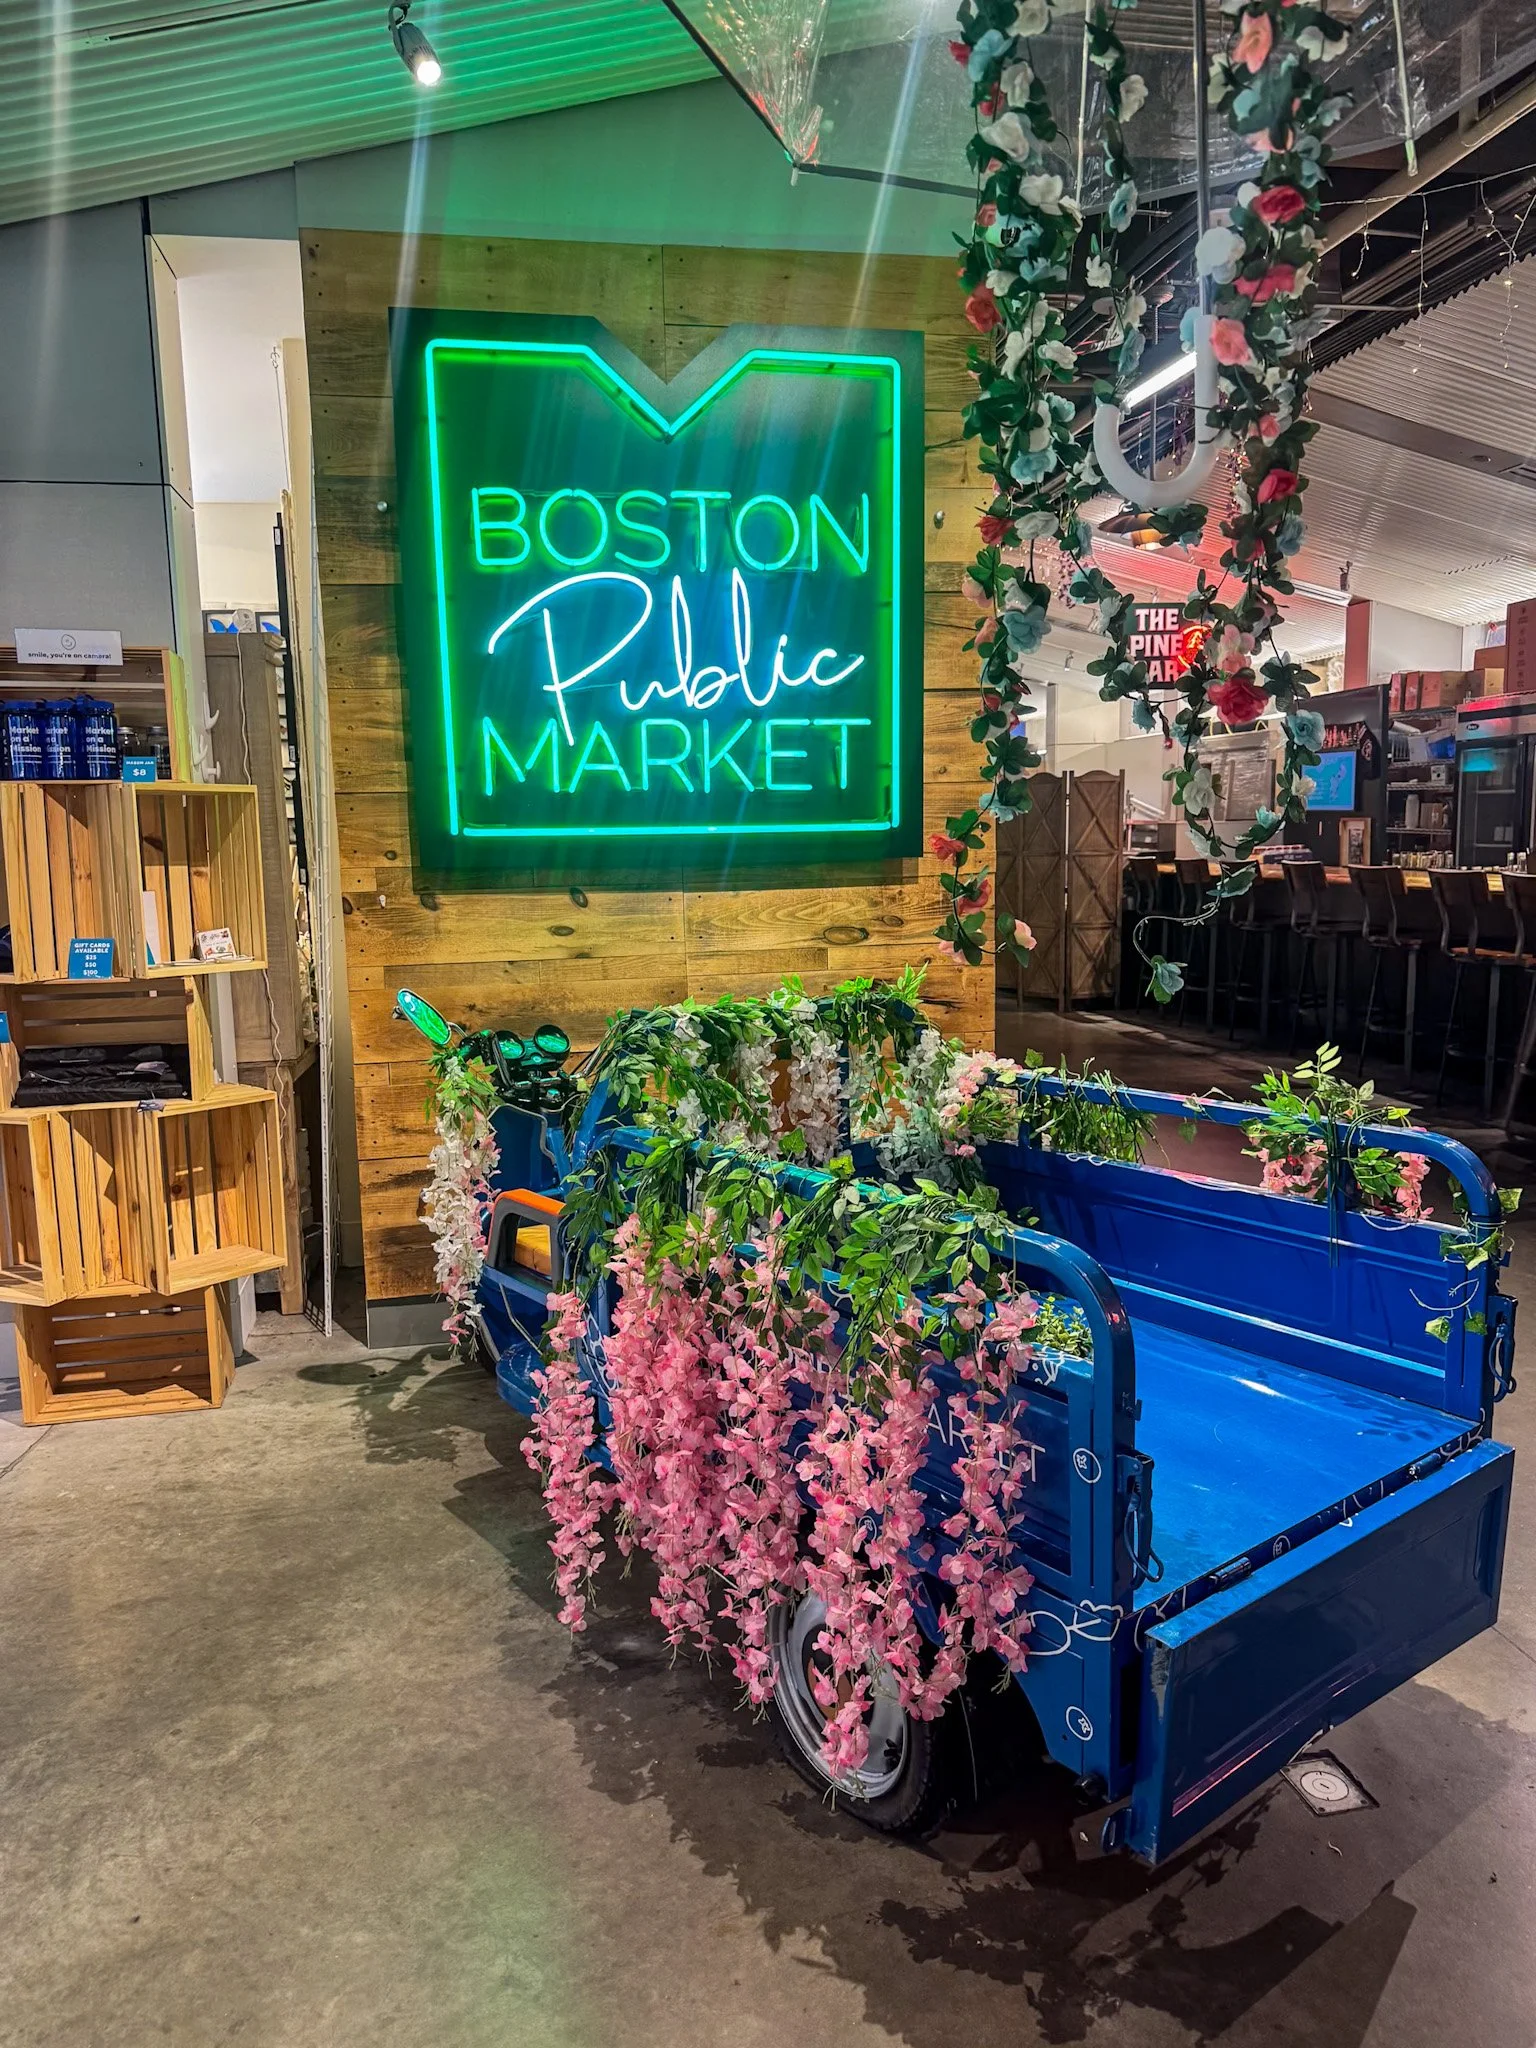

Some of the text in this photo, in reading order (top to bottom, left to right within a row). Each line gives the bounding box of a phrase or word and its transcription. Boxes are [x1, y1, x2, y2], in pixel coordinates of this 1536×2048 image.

[471, 487, 869, 573] BOSTON
[1135, 608, 1179, 631] THE
[50, 652, 72, 660] you're
[487, 567, 865, 745] Public
[1129, 633, 1184, 658] PINE
[1148, 659, 1180, 682] AR
[10, 726, 39, 734] Market
[85, 726, 114, 735] Market
[86, 744, 117, 753] Mission
[482, 716, 871, 796] MARKET
[132, 768, 146, 776] $8
